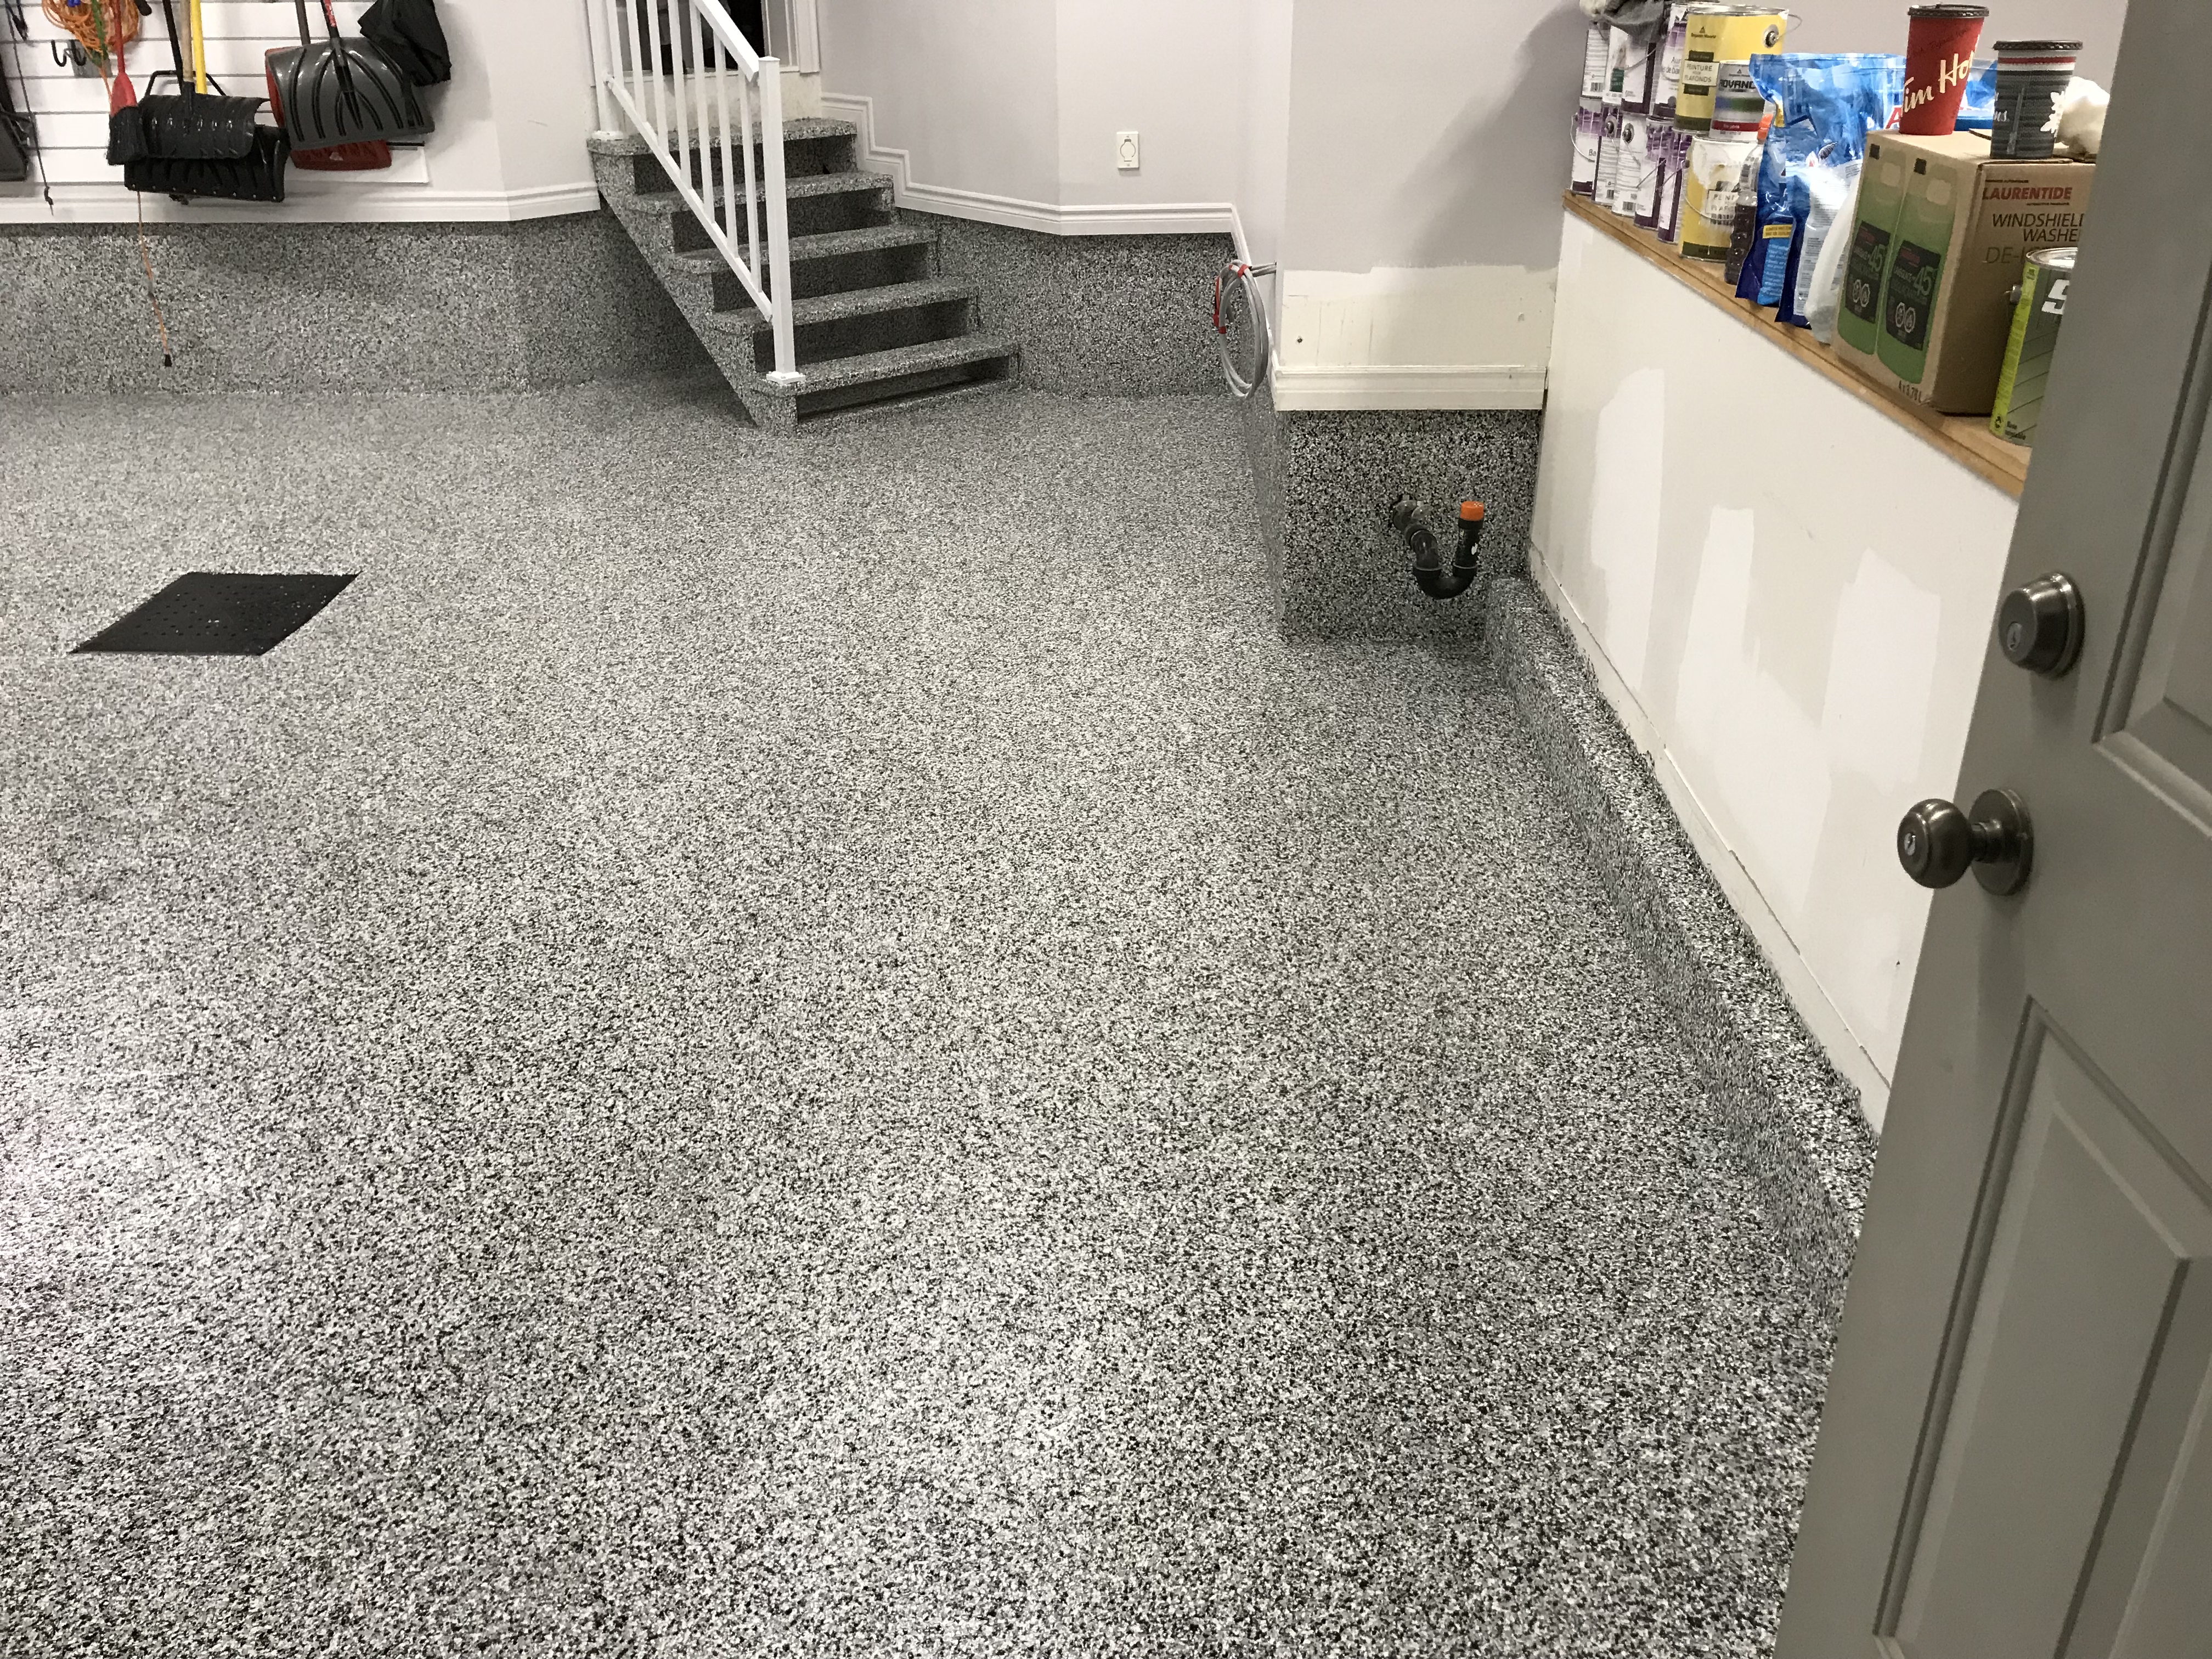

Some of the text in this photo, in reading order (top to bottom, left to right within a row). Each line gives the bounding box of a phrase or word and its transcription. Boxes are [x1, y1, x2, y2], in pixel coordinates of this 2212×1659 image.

[1686, 63, 1713, 72] PEINTURE
[1719, 79, 1756, 89] ADVANC
[1901, 77, 1935, 117] Tim
[1982, 187, 2073, 200] LAURENTIDE
[2023, 228, 2079, 242] WASHE
